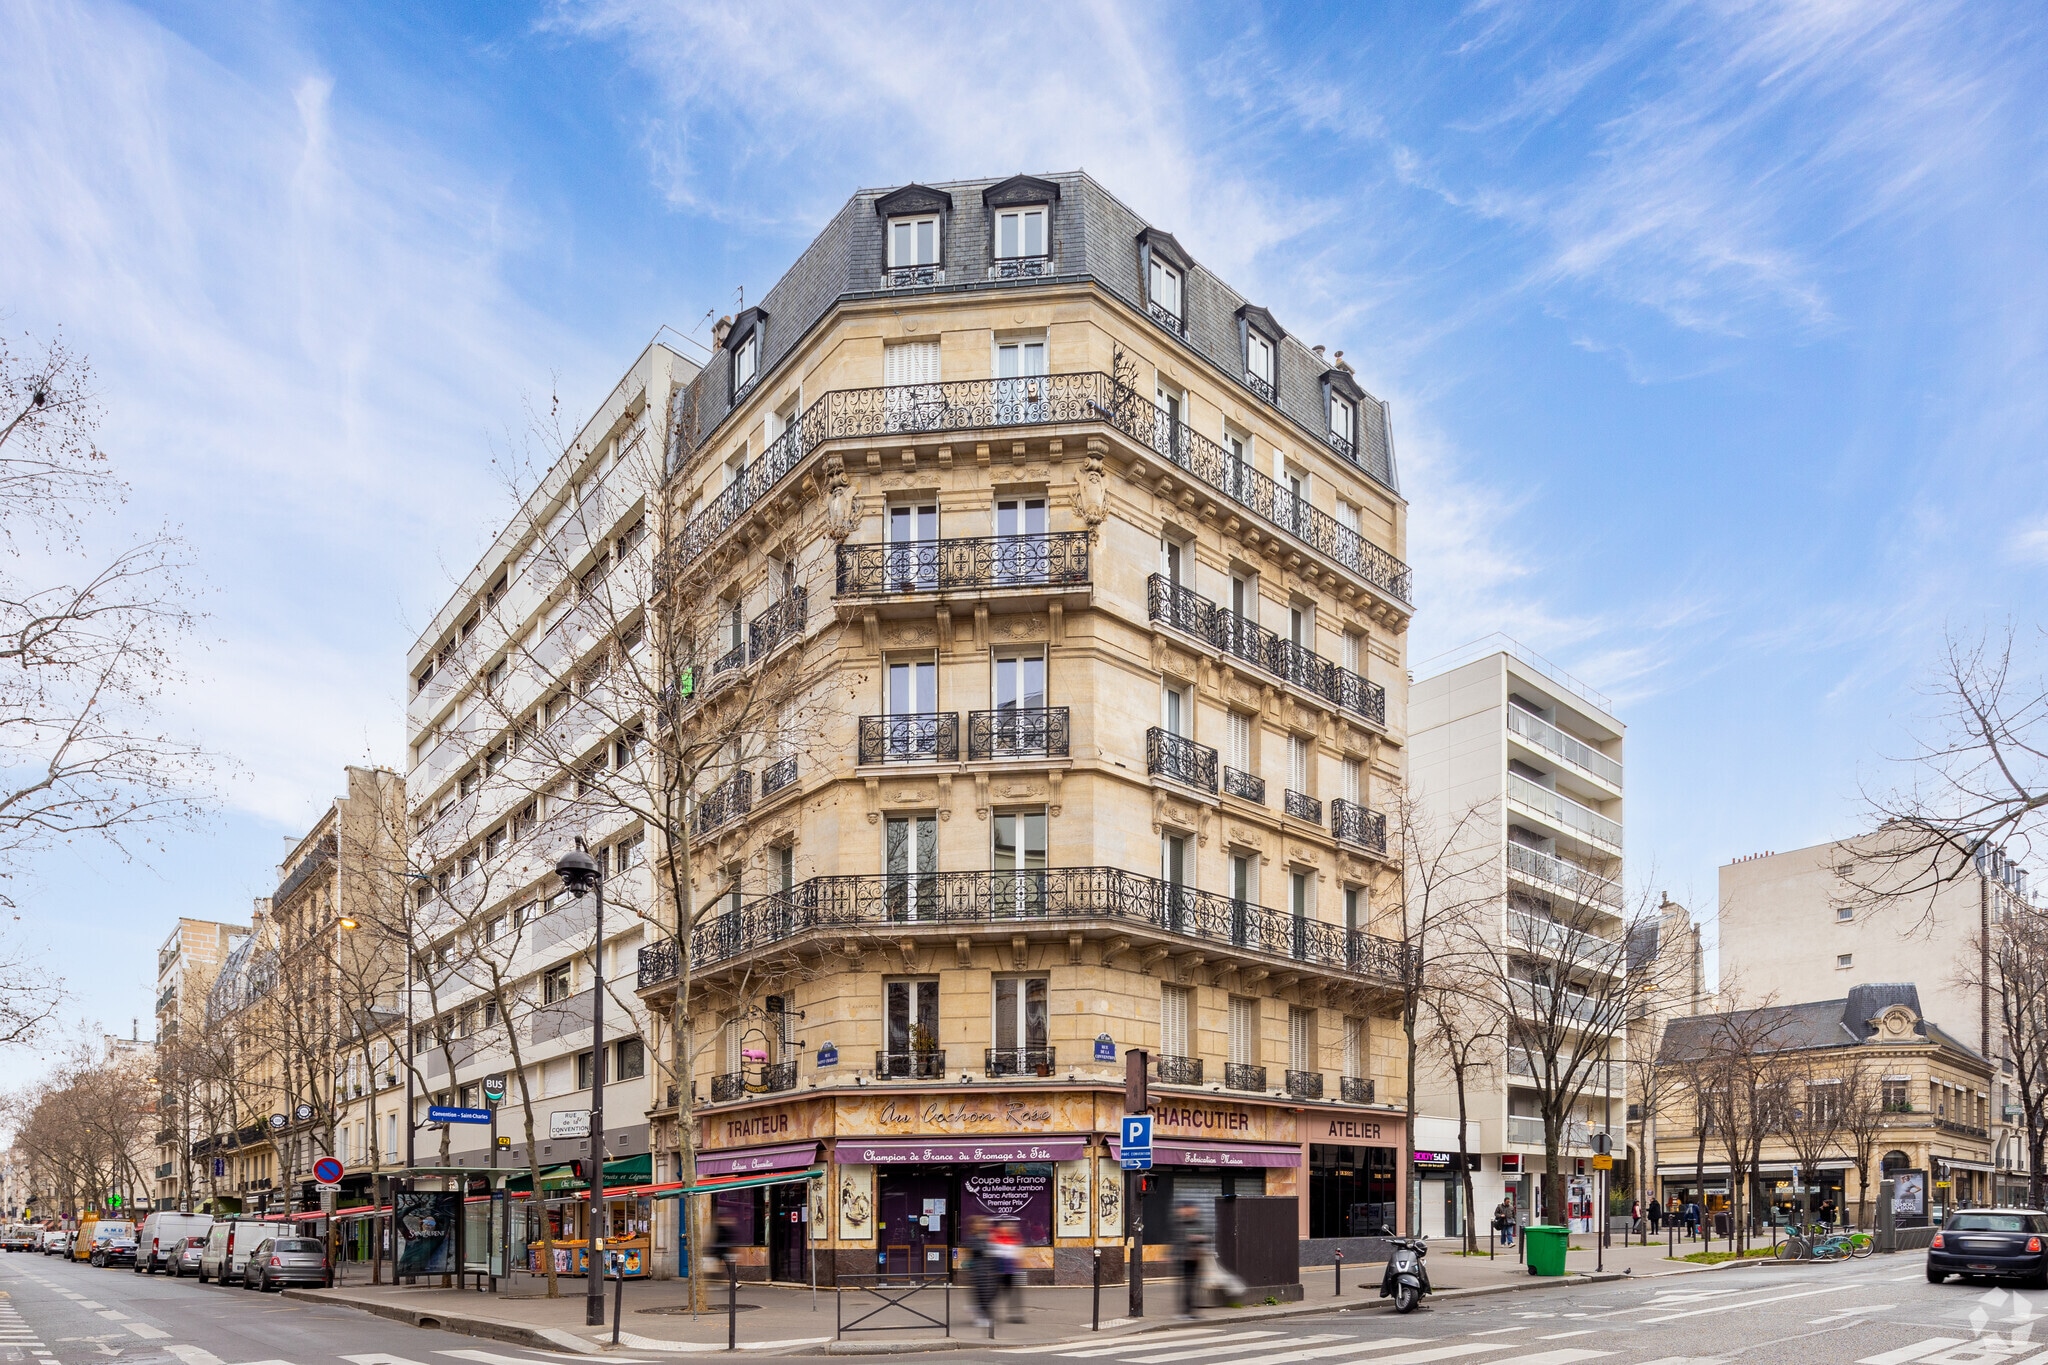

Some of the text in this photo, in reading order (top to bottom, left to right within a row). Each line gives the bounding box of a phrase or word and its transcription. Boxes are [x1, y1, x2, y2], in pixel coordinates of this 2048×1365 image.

[486, 1079, 503, 1089] BUS
[432, 1110, 457, 1118] Convention
[880, 1101, 1051, 1126] Au Cochon Rose
[551, 1125, 589, 1133] CONVENTION
[727, 1114, 788, 1138] TRAITEUR
[1328, 1120, 1381, 1139] ATELIER
[1129, 1122, 1144, 1143] P
[863, 1146, 1051, 1162] Champion de France du Fromage de Tête
[1184, 1151, 1244, 1165] Fabrication Maison
[970, 1175, 1047, 1185] Coupe de France
[981, 1184, 991, 1192] du
[991, 1184, 1016, 1192] Meilleur
[997, 1206, 1013, 1214] 2007
